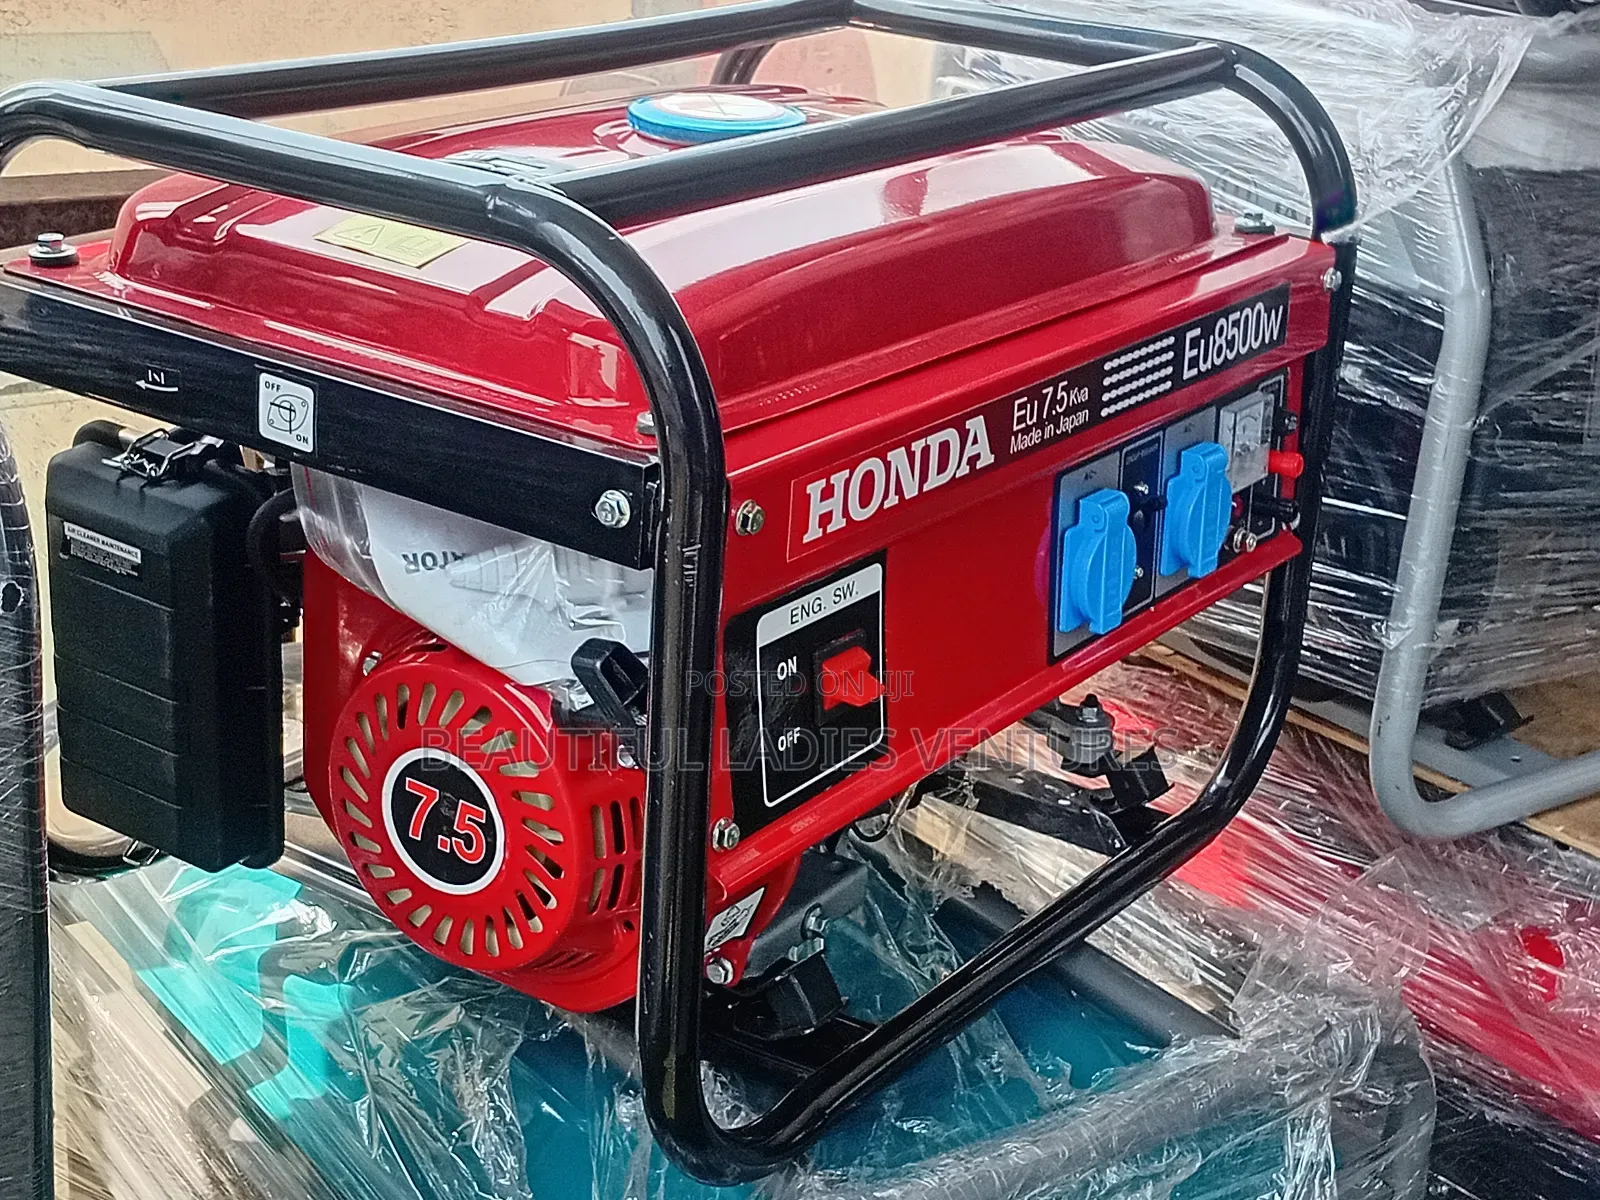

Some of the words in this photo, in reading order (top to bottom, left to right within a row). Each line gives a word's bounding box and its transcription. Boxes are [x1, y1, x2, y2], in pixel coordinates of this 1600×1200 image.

[1182, 301, 1284, 381] Eu8500w
[264, 380, 281, 393] OFF
[1012, 396, 1038, 432] Eu
[1041, 380, 1069, 420] 7.5
[1069, 385, 1089, 409] Kva
[295, 433, 309, 445] ON
[1010, 430, 1042, 454] Made
[1044, 422, 1054, 439] in
[1056, 407, 1089, 435] Japan
[802, 414, 995, 544] HONDA
[76, 530, 100, 543] CLEANER
[101, 540, 139, 559] MAINTENANCE
[789, 596, 827, 625] ENG.
[832, 580, 859, 605] SW.
[777, 656, 797, 680] ON
[777, 727, 801, 751] OFF
[405, 777, 487, 864] 7.5
